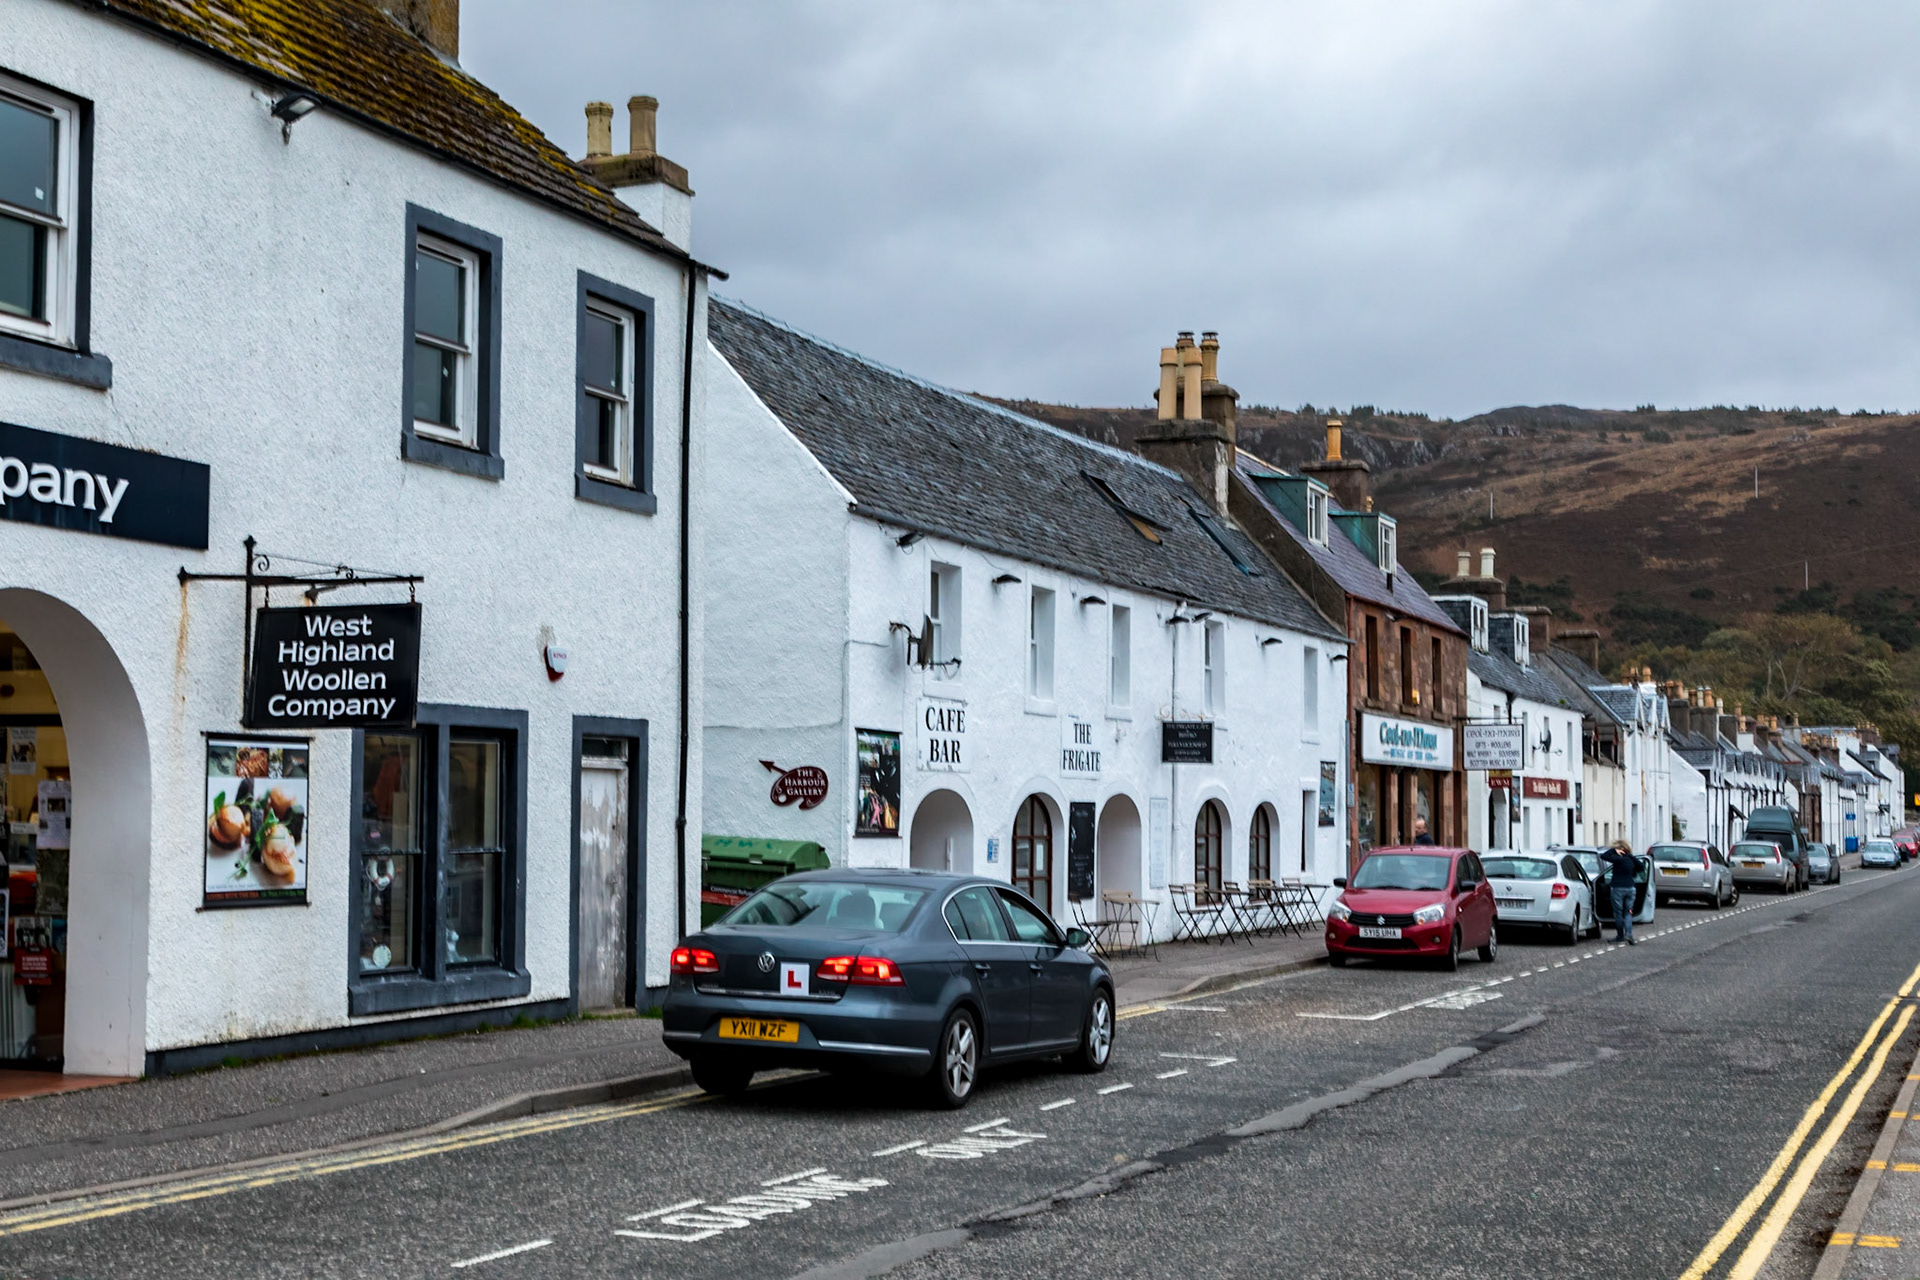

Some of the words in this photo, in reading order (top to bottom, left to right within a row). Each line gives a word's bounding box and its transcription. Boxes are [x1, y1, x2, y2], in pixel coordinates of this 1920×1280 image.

[304, 614, 373, 637] West
[278, 638, 395, 666] Highland
[282, 668, 387, 691] Woollen
[268, 694, 397, 720] Company
[925, 706, 966, 733] CAFE
[1073, 722, 1092, 745] THE
[929, 738, 962, 764] BAR
[1062, 749, 1101, 772] FRIGATE
[784, 778, 826, 786] HARBOUR
[796, 769, 814, 777] THE
[786, 787, 824, 796] GALLERY
[787, 970, 802, 988] L
[731, 1020, 755, 1037] YX11
[759, 1022, 787, 1038] WZF
[614, 1174, 889, 1242] LOADING
[916, 1127, 1047, 1159] ONLY
